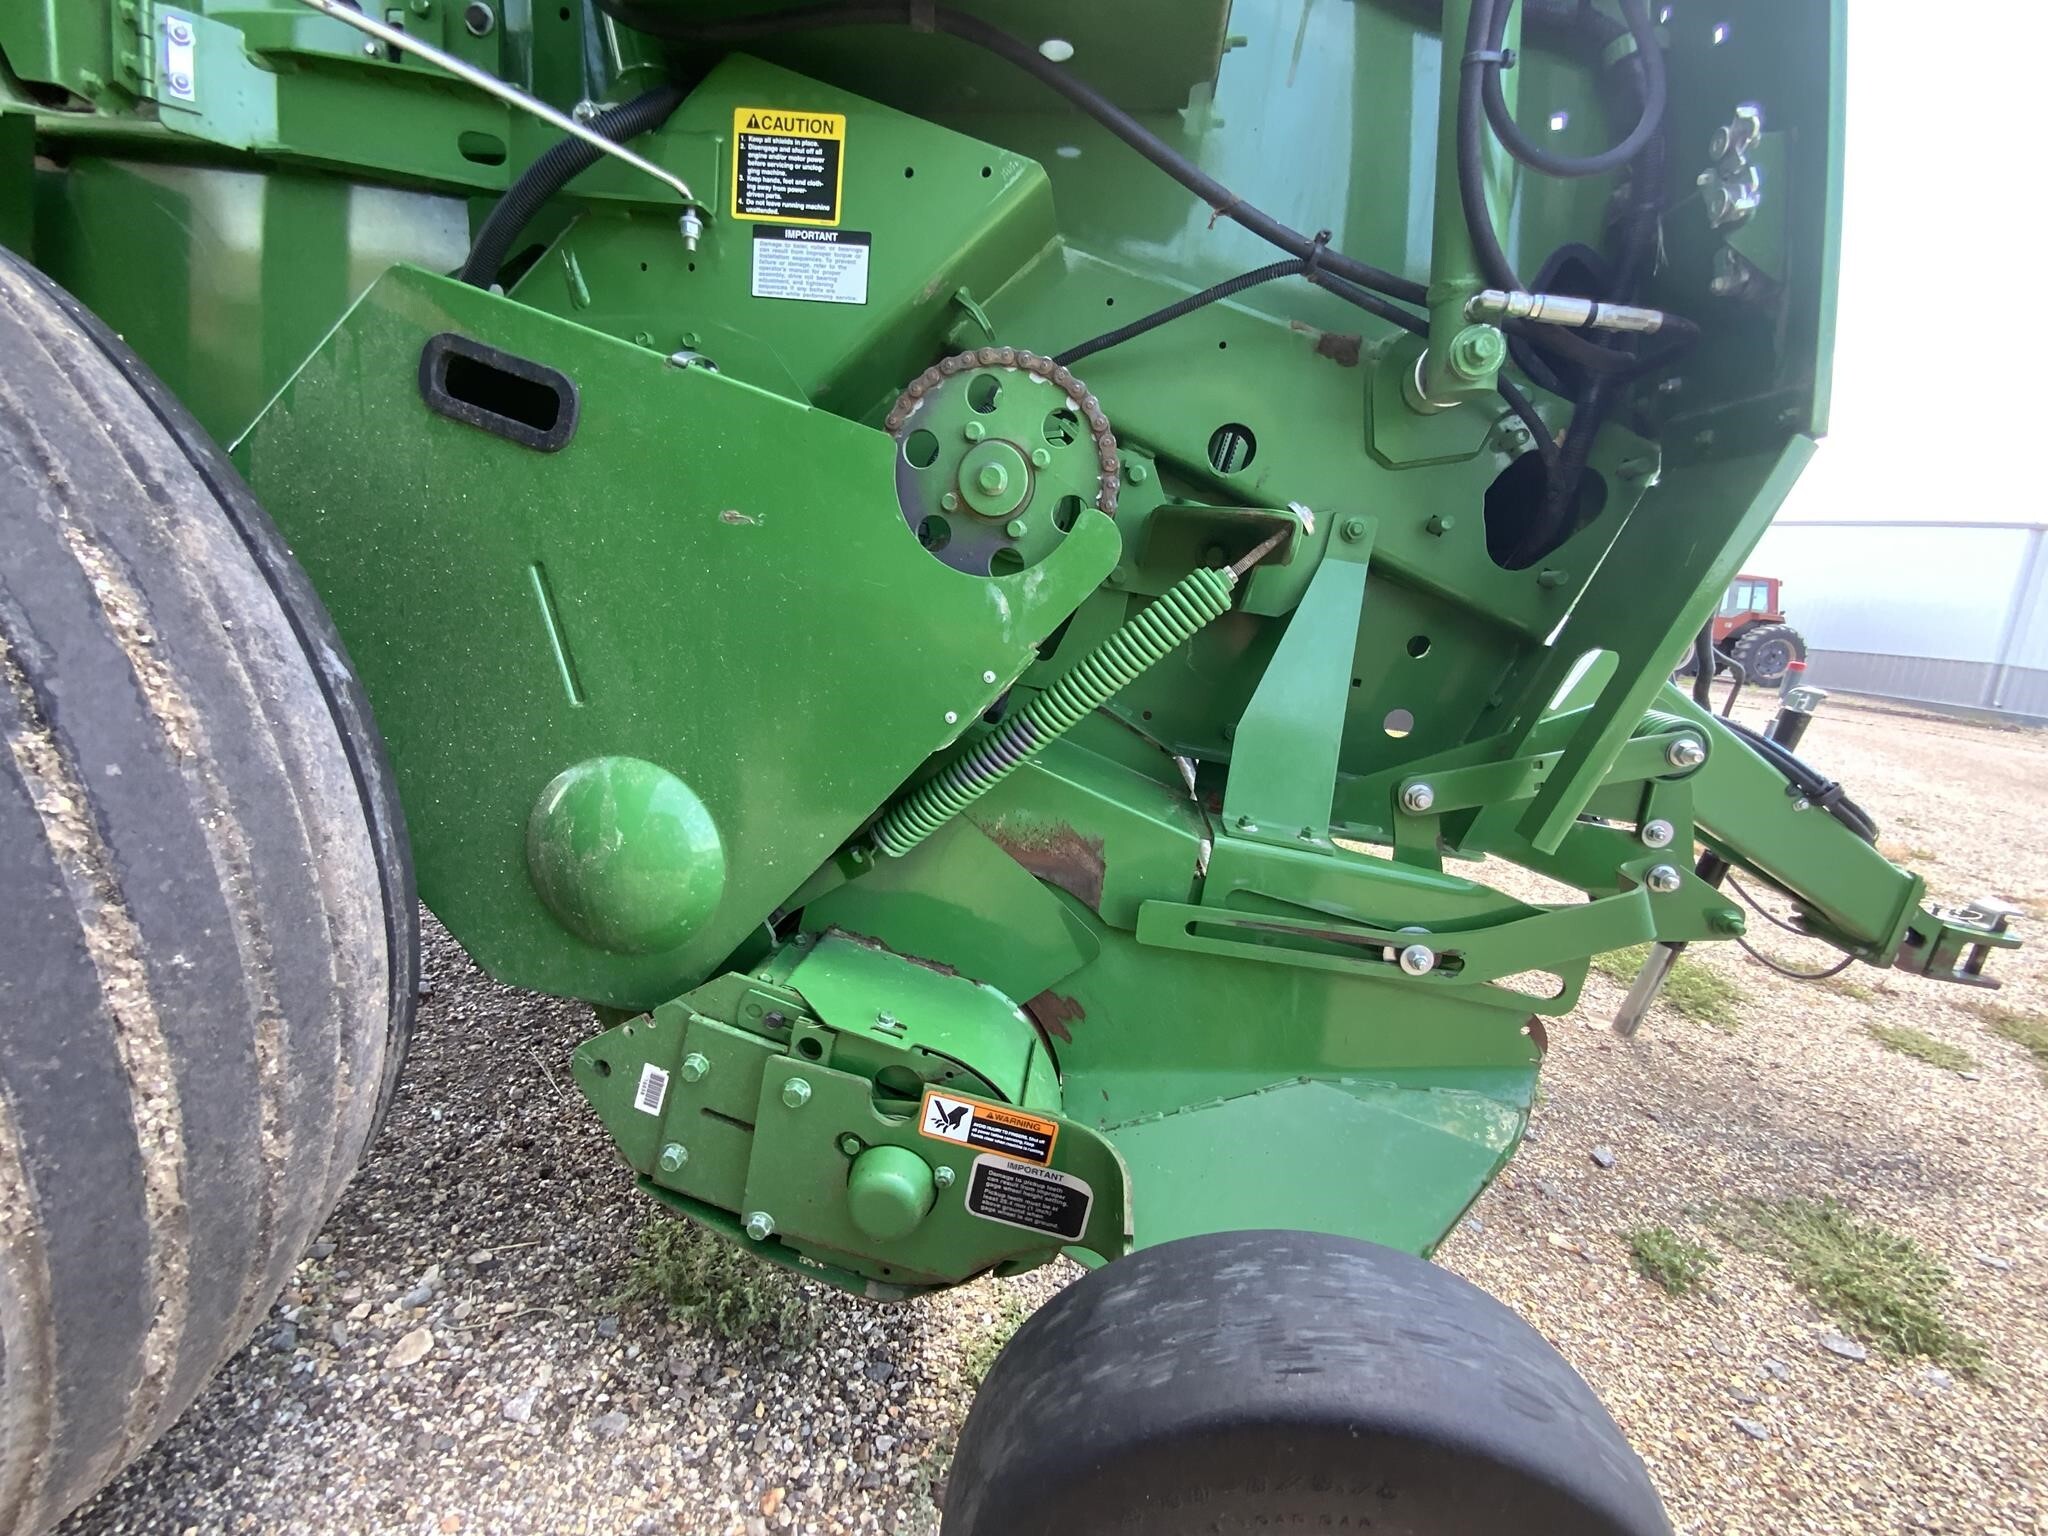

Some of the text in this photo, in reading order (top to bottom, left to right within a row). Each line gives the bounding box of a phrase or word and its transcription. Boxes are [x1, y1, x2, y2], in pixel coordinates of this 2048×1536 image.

[762, 116, 834, 134] CAUTION
[785, 229, 838, 241] IMPORTANT
[993, 1114, 1041, 1131] WARNING
[1007, 1162, 1064, 1182] IMPORTANT
